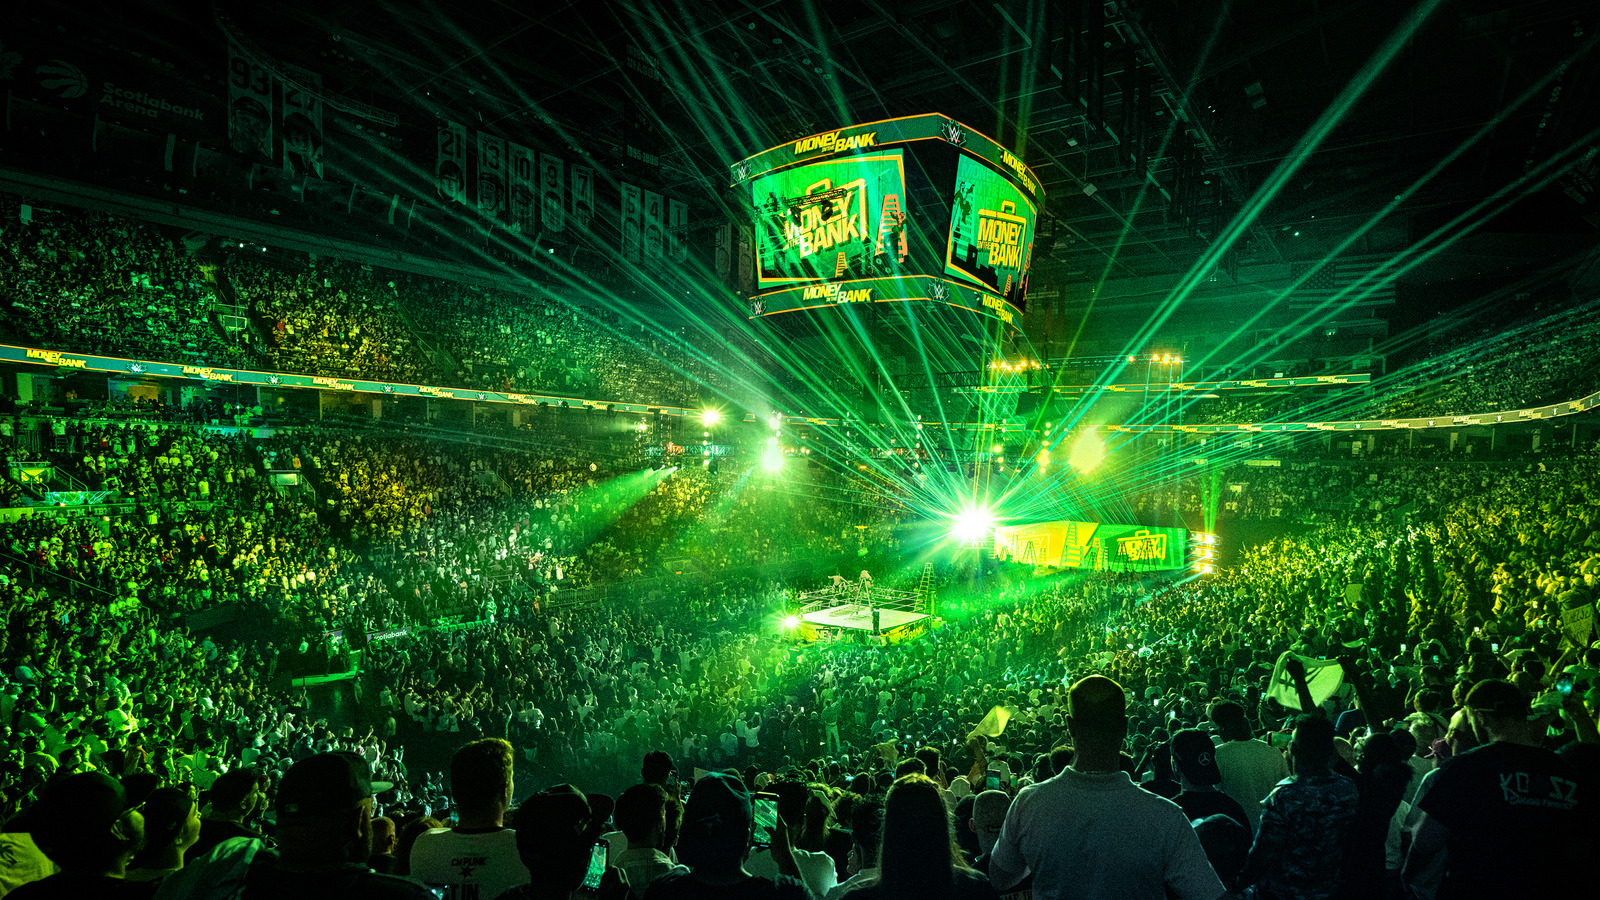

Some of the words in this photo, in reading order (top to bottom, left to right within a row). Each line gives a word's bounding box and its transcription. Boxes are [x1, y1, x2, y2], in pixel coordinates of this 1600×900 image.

[231, 57, 269, 95] 93
[100, 93, 159, 119] Arena
[103, 81, 205, 120] Scotiabank
[441, 130, 461, 158] 21
[482, 140, 500, 169] 13
[794, 130, 841, 155] MONEY
[834, 132, 876, 153] BANK
[513, 155, 530, 181] 10
[546, 166, 558, 188] 9
[1003, 150, 1027, 175] MONEY
[1022, 175, 1036, 196] BANK
[800, 213, 860, 258] BANK
[978, 217, 1022, 245] MONEY
[989, 243, 1020, 267] BANK
[803, 283, 843, 301] MONEY
[836, 288, 873, 304] BANK
[26, 349, 62, 361] MONEY
[58, 358, 86, 368] BANK
[183, 366, 213, 375] MONEY
[209, 373, 233, 381] BANK
[312, 377, 338, 385] MONEY
[334, 383, 355, 391] BANK
[1548, 775, 1579, 805] SZ
[463, 857, 487, 867] PUNK
